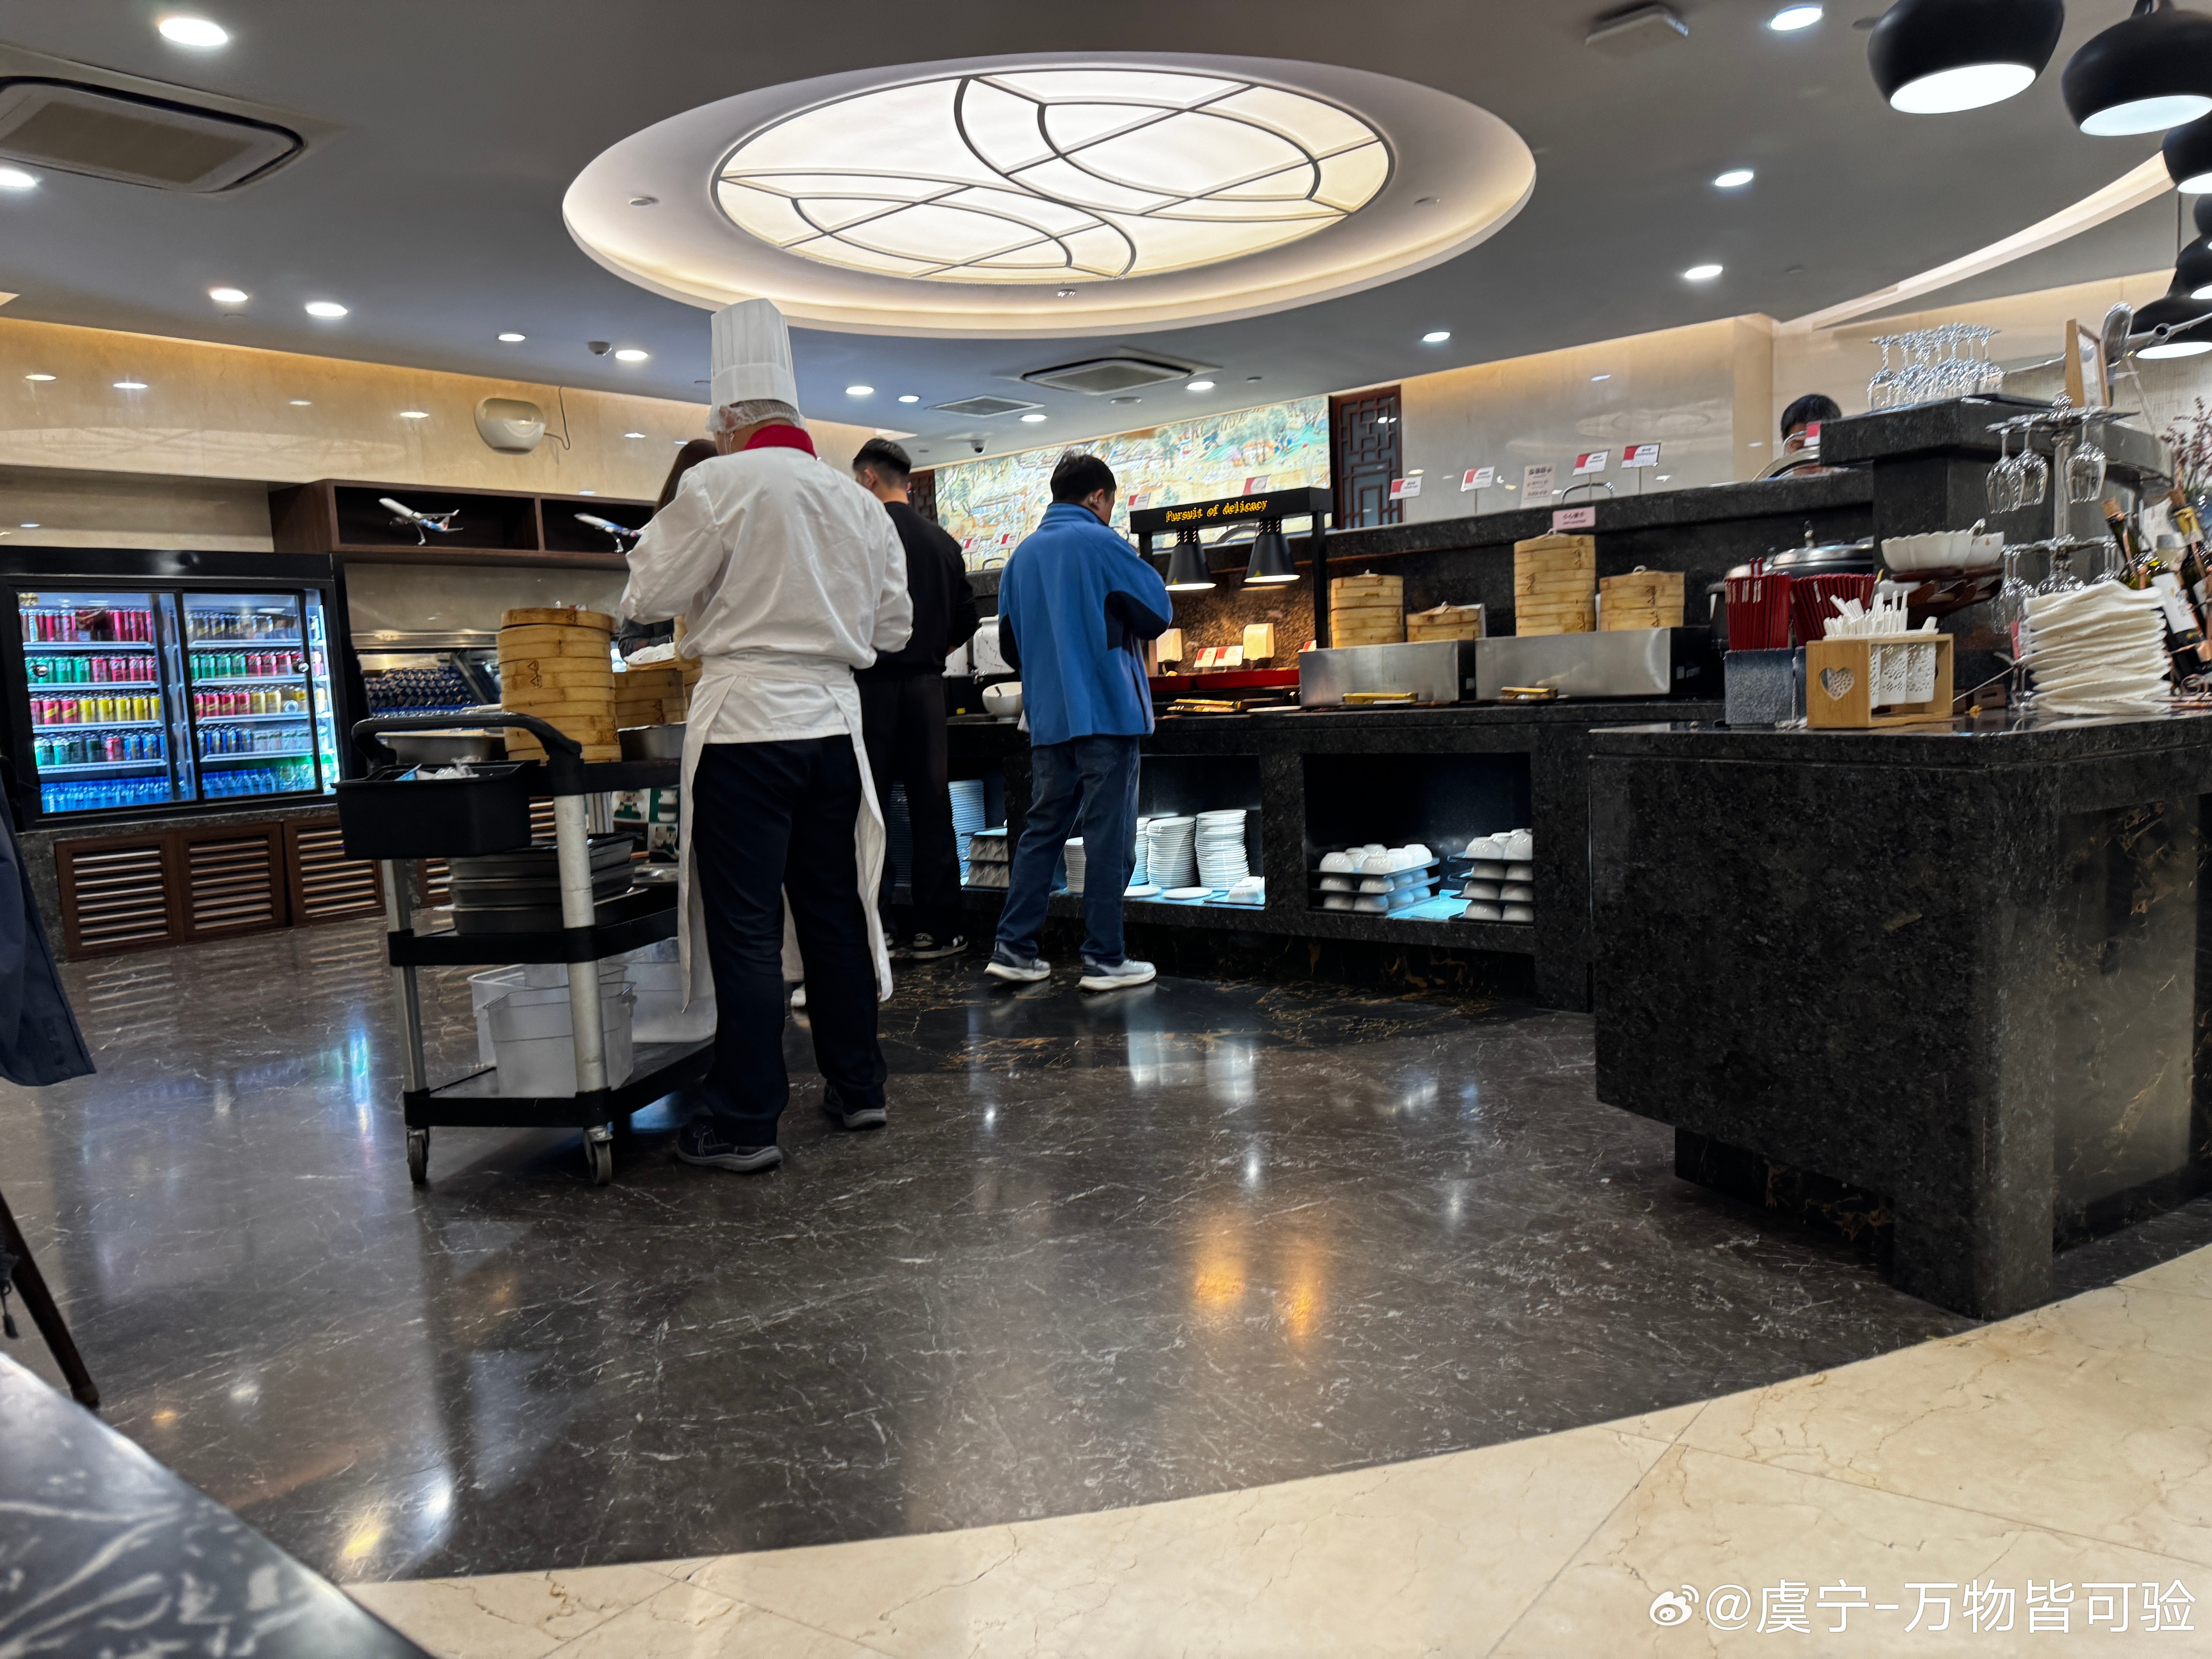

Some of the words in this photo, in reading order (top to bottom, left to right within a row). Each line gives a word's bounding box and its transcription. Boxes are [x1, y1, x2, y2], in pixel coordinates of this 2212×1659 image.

[1166, 507, 1203, 522] Pursuit
[1207, 504, 1219, 517] of
[1222, 500, 1268, 515] delicacy
